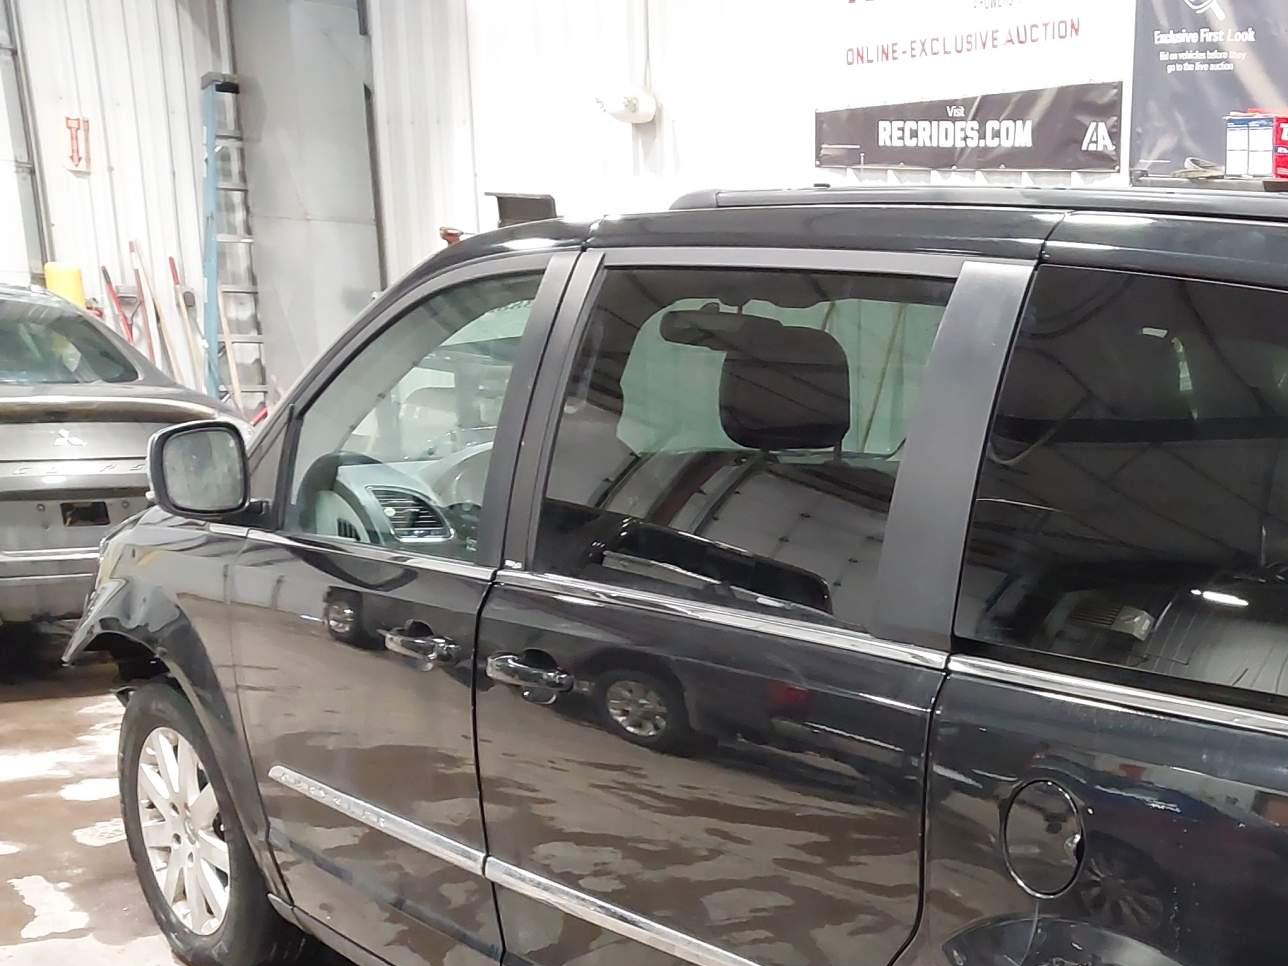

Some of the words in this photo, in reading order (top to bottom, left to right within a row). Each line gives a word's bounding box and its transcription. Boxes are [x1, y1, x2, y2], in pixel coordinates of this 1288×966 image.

[846, 29, 999, 66] ONLINE-EXCLUSIVE
[1004, 18, 1080, 45] AUCTION
[1154, 29, 1199, 44] Exclusive
[1200, 28, 1225, 43] First
[1227, 27, 1256, 42] Look
[946, 106, 966, 117] Visit
[878, 120, 1033, 147] RECRIDES.COM
